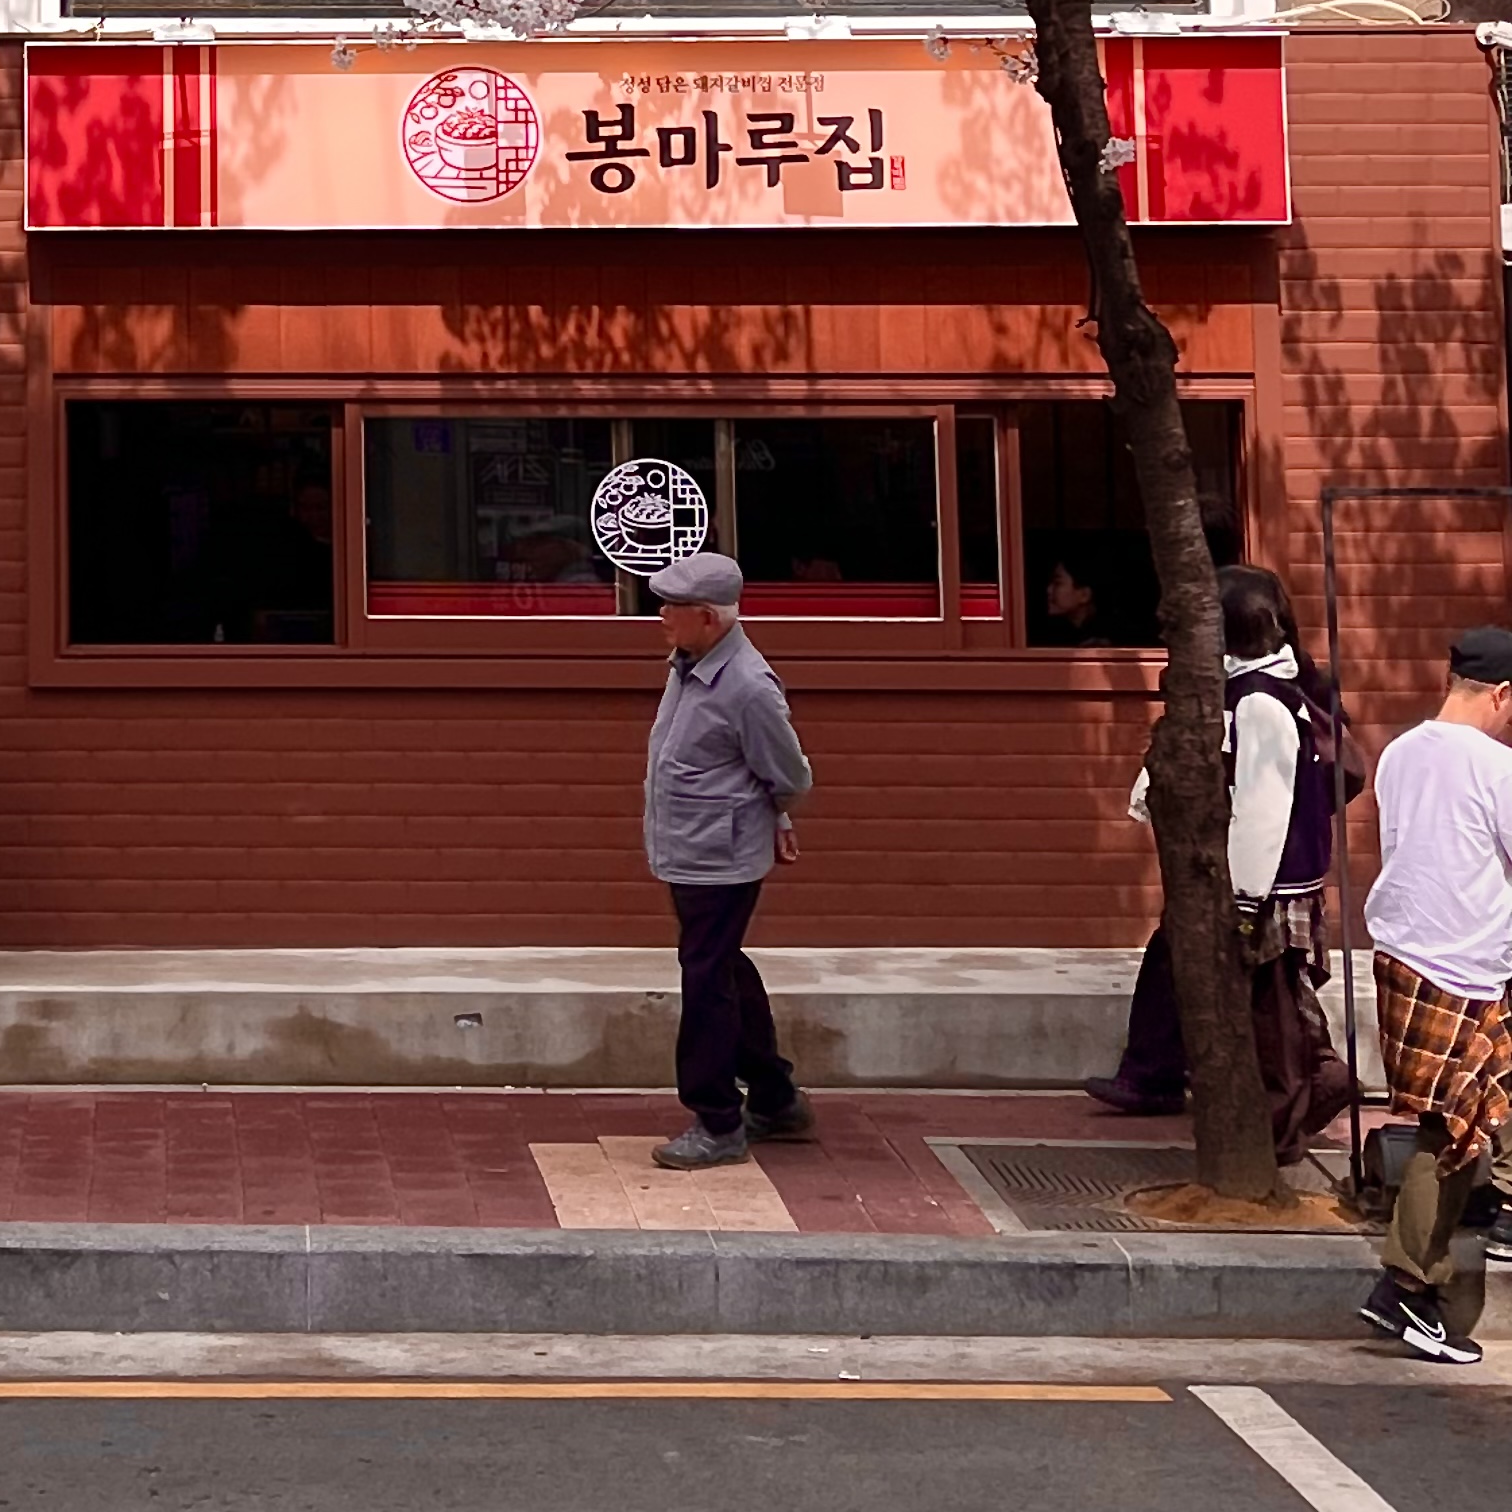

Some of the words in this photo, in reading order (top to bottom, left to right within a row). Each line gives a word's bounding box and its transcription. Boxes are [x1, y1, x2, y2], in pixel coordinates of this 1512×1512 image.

[620, 75, 651, 94] 정성
[656, 75, 689, 93] 담은
[565, 102, 885, 195] 봉마루집
